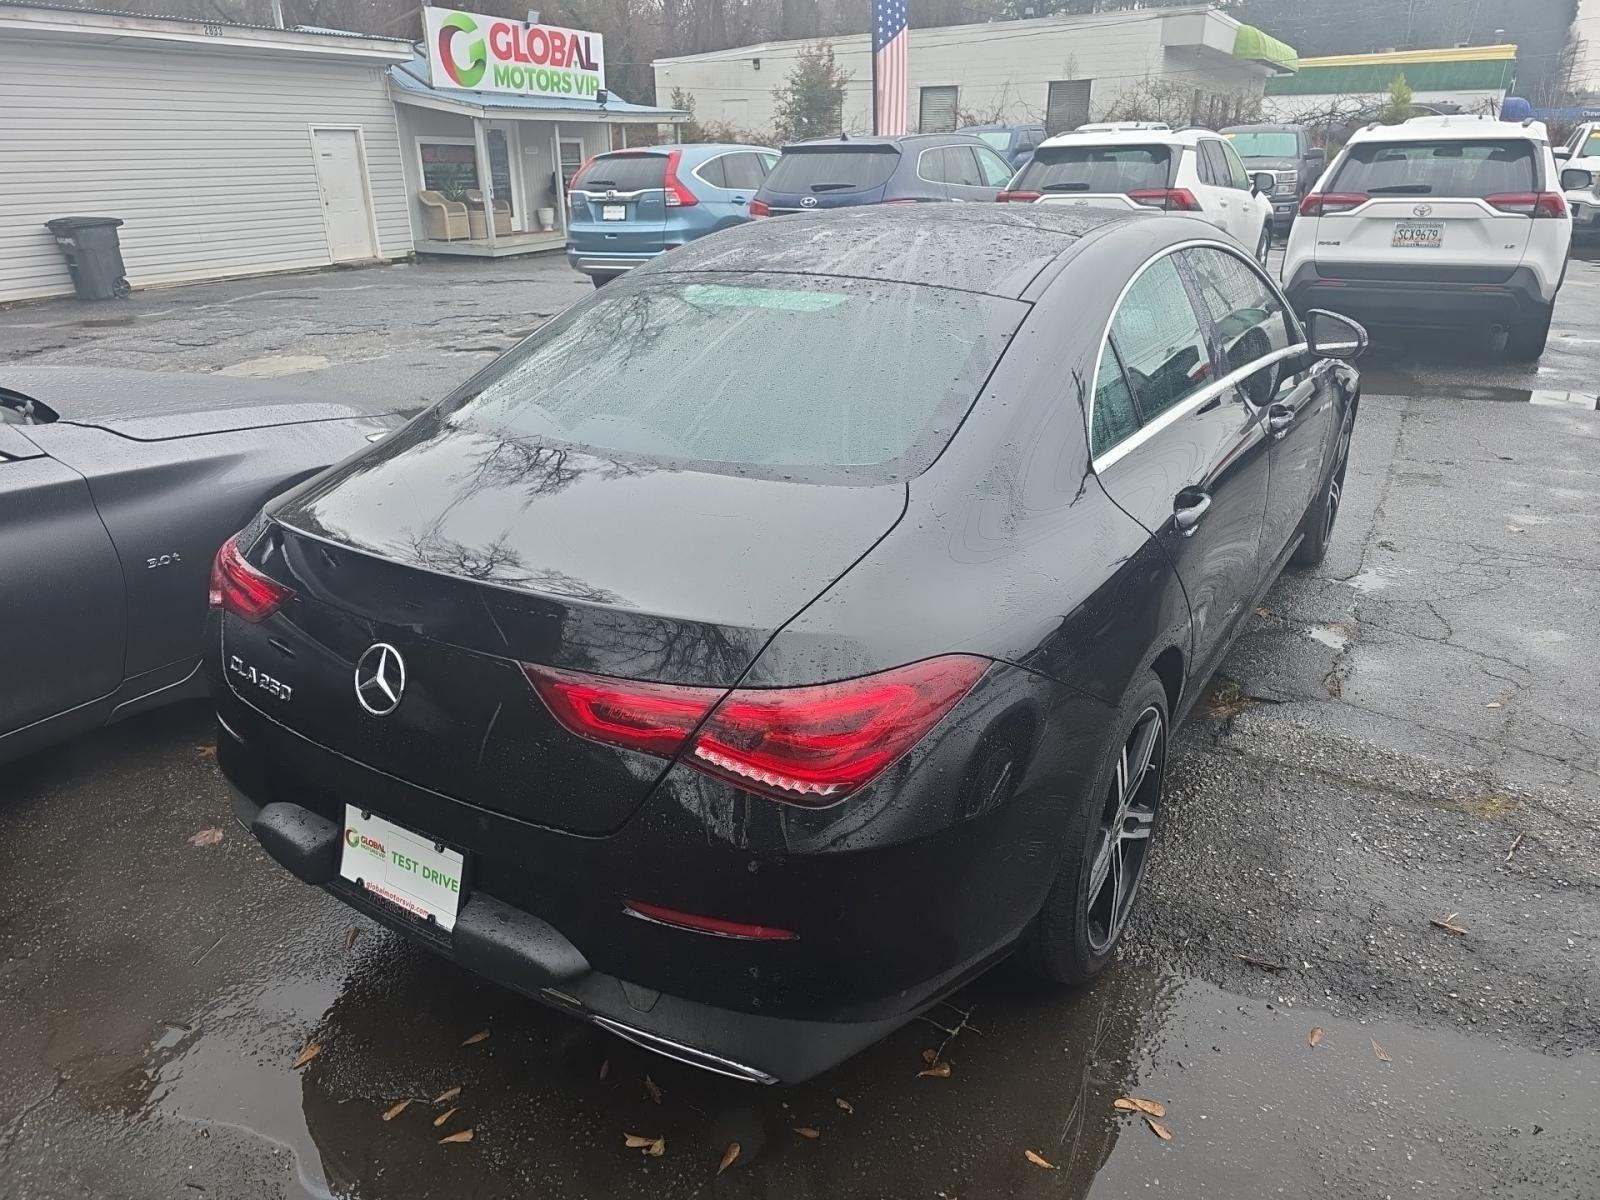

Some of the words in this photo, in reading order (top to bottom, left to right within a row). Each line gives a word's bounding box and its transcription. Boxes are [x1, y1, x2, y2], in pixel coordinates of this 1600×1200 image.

[489, 22, 599, 72] GLOBAL
[493, 64, 572, 95] MOTORS
[574, 74, 600, 96] VIP
[1398, 229, 1439, 241] SCX9679
[230, 655, 257, 684] CLA
[259, 673, 292, 702] 250
[360, 835, 386, 853] GLOBAL
[391, 851, 419, 873] TEST
[422, 866, 459, 893] DRIVE
[365, 881, 429, 916] globalmotorsvip.com
